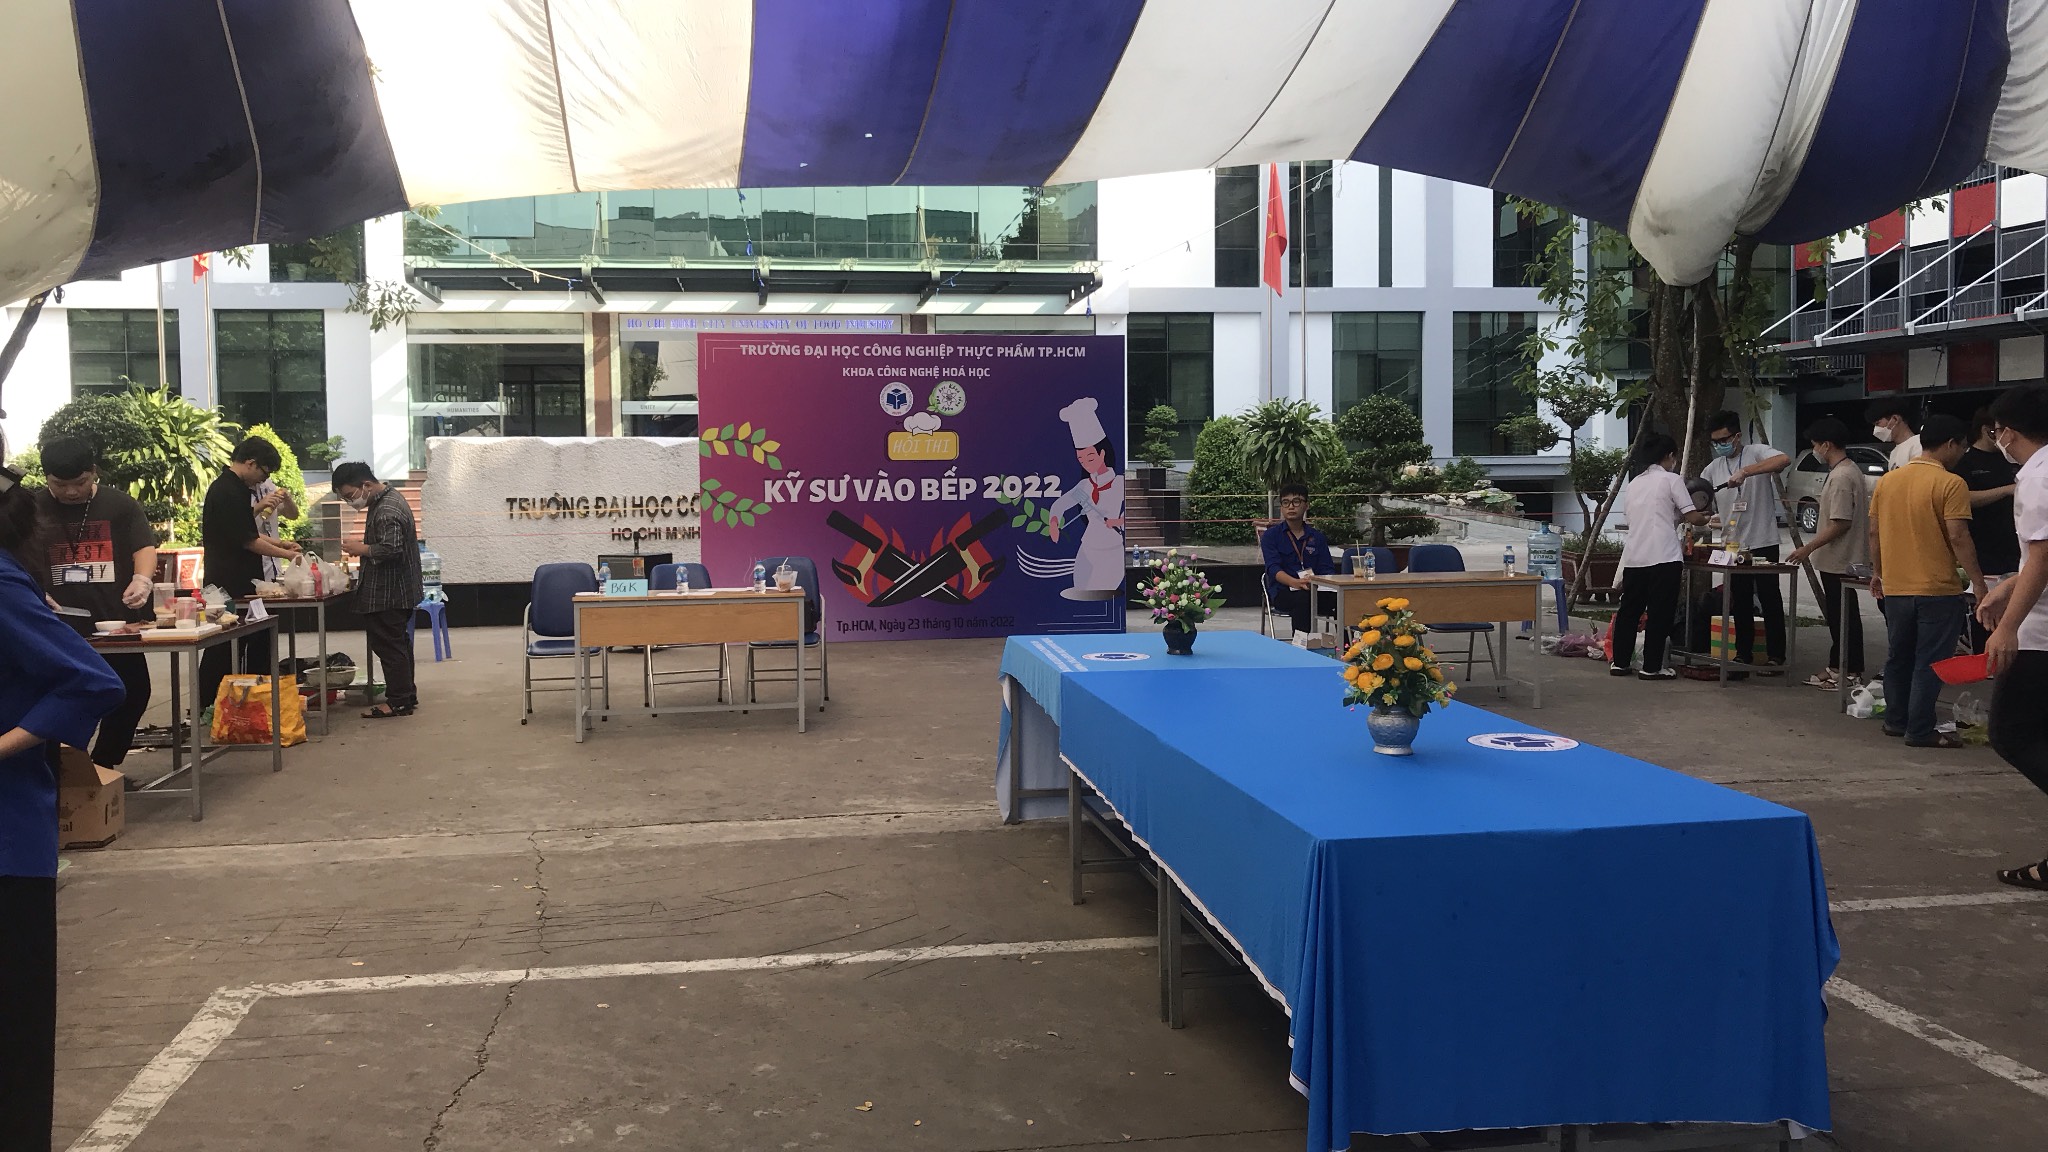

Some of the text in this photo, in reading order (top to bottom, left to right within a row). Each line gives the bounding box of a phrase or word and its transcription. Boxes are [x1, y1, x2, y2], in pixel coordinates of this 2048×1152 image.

[702, 319, 725, 329] CITY
[731, 319, 791, 329] UNIVERSITY
[814, 320, 841, 330] FOOD
[846, 320, 894, 330] INDUSTRY
[740, 342, 1086, 360] TRƯỜNG ĐẠI HỌC CÔNG NGHIỆP THỰC PHẨM TP.HCM
[842, 365, 991, 379] KHOA CÔNG NGHỆ HOÁ HỌC
[892, 434, 951, 457] HỘI THI
[764, 466, 1062, 503] KỸ SƯ VÀO BẾP 2022
[631, 495, 673, 523] HỌC
[836, 620, 877, 634] Tp.HCM,
[879, 619, 906, 633] Ngày
[908, 618, 920, 630] 23
[922, 617, 950, 631] tháng
[953, 617, 964, 628] 10
[990, 616, 1015, 628] 2022
